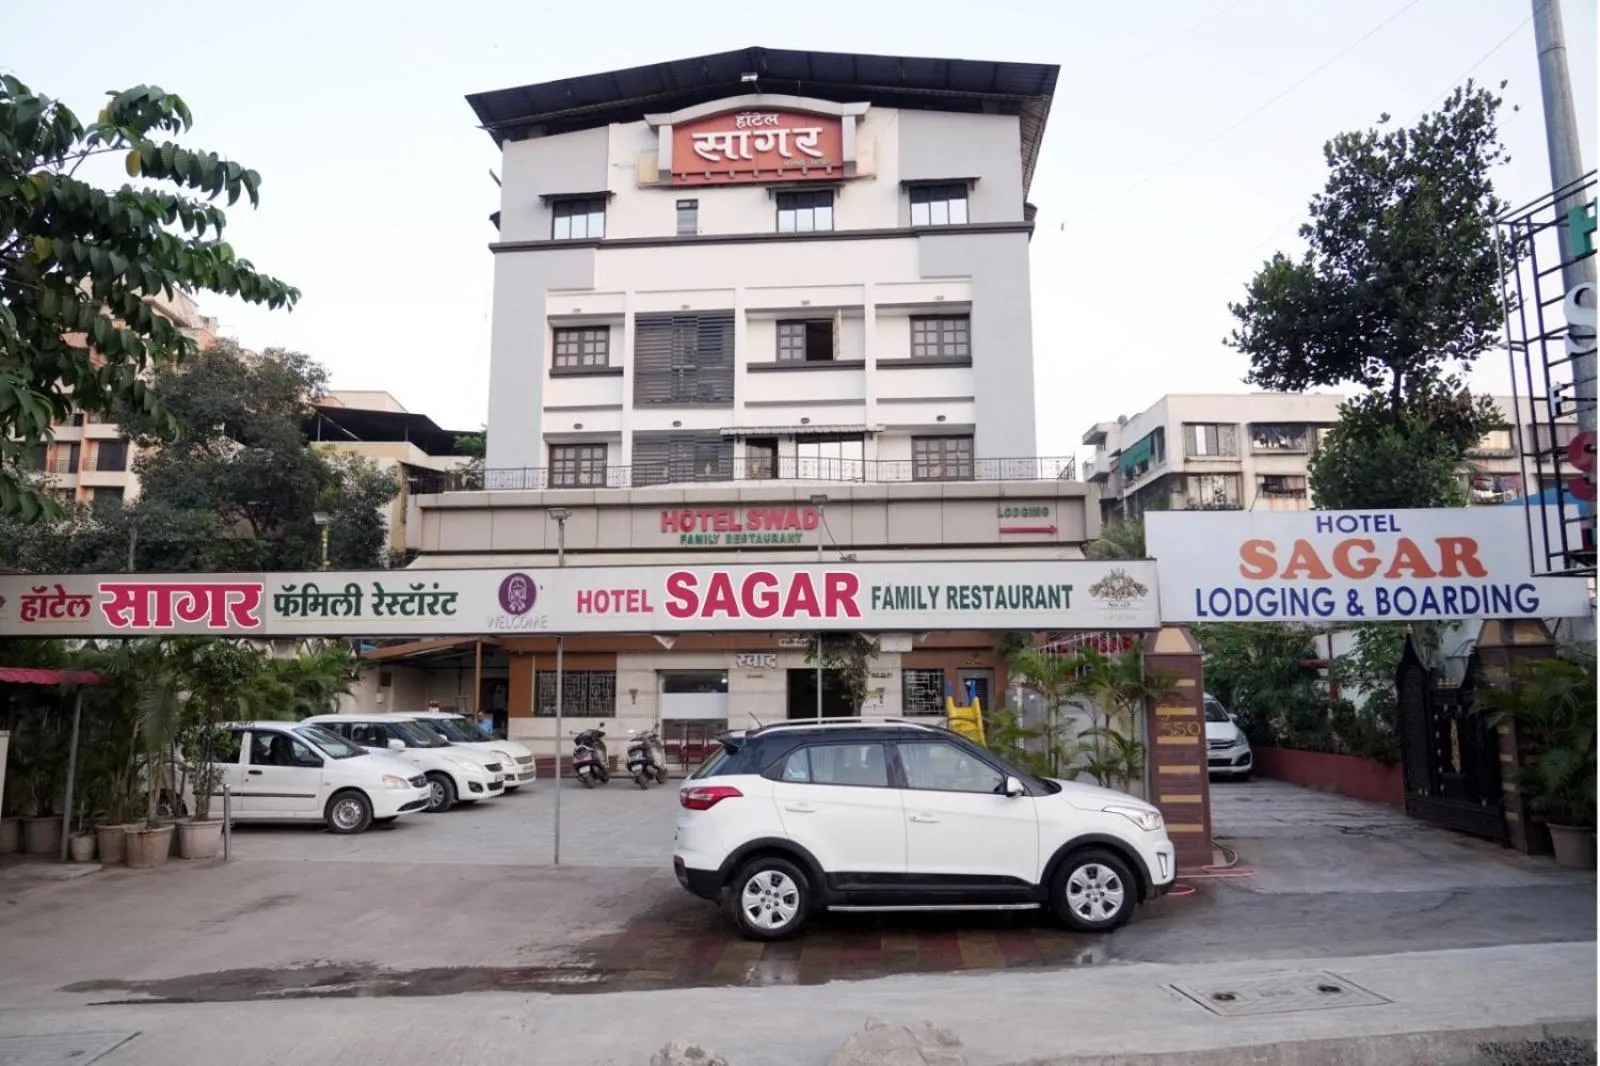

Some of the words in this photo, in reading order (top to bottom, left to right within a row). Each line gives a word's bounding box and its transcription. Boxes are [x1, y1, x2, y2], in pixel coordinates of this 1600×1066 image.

[735, 111, 779, 129] हॉटेल
[692, 127, 822, 162] सागर
[661, 508, 742, 533] HOTEL
[746, 506, 819, 531] SWAD
[996, 506, 1050, 518] LODGING
[1316, 514, 1401, 534] HOTEL
[680, 534, 720, 545] FAMILY
[725, 532, 803, 544] RESTAURANT
[1239, 536, 1488, 580] SAGAR
[20, 583, 92, 622] हॉटेल
[98, 582, 264, 629] सागर
[273, 582, 363, 617] फॅमिली
[371, 581, 459, 617] रेस्टॉरंट
[577, 589, 654, 613] HOTEL
[664, 570, 863, 619] SAGAR
[871, 584, 940, 610] FAMILY
[949, 584, 1073, 610] RESTAURANT
[1196, 587, 1336, 618] LODGING
[1346, 589, 1366, 616] &
[1376, 583, 1540, 617] BOARDING
[486, 615, 548, 630] WELCOME
[735, 653, 777, 669] स्वाद
